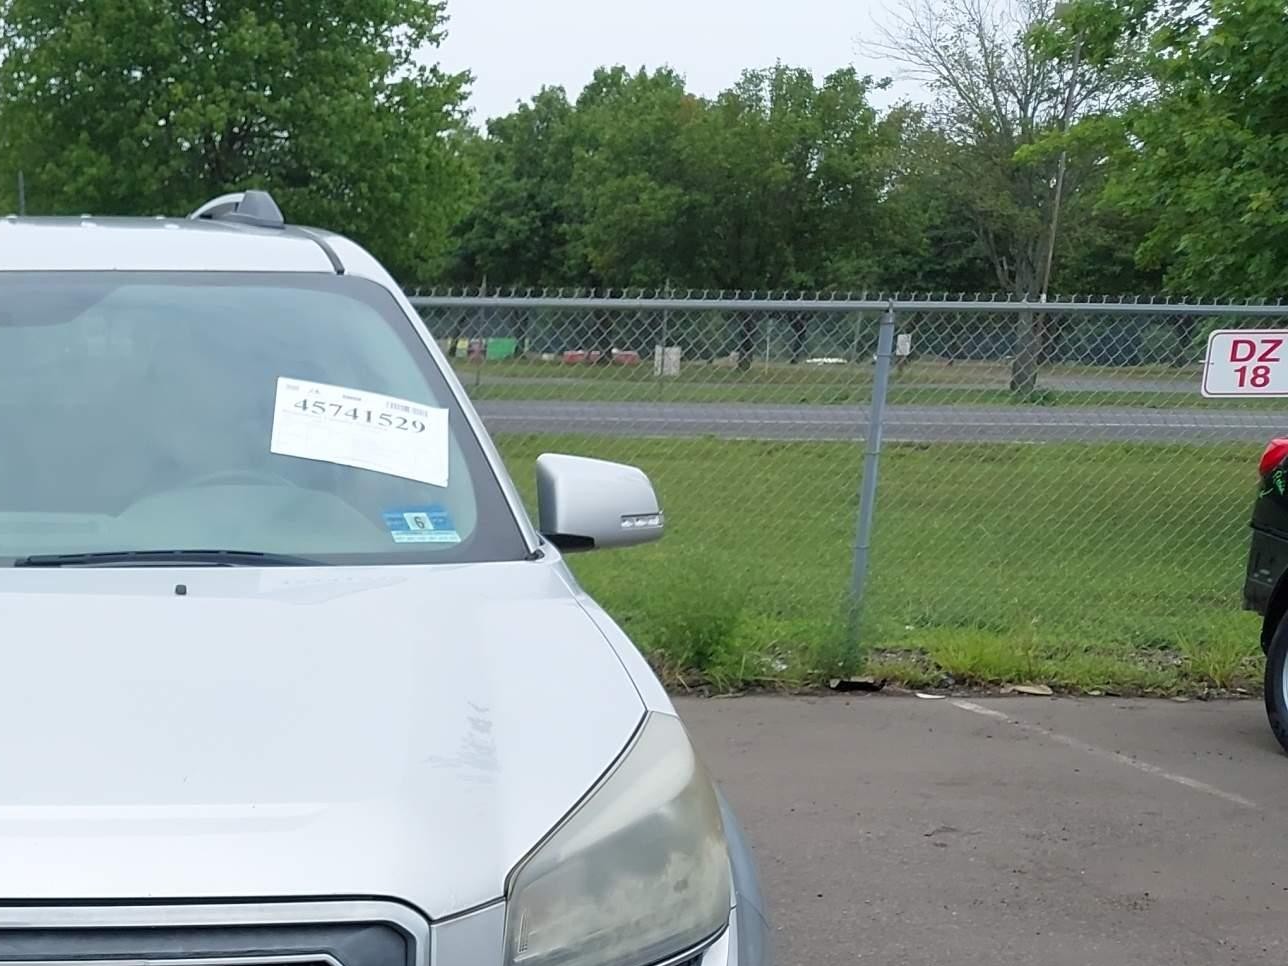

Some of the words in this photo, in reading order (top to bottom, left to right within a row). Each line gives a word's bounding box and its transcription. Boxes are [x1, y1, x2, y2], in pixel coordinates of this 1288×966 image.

[1229, 339, 1284, 363] DZ
[1233, 365, 1271, 388] 18
[293, 398, 427, 434] 45741529
